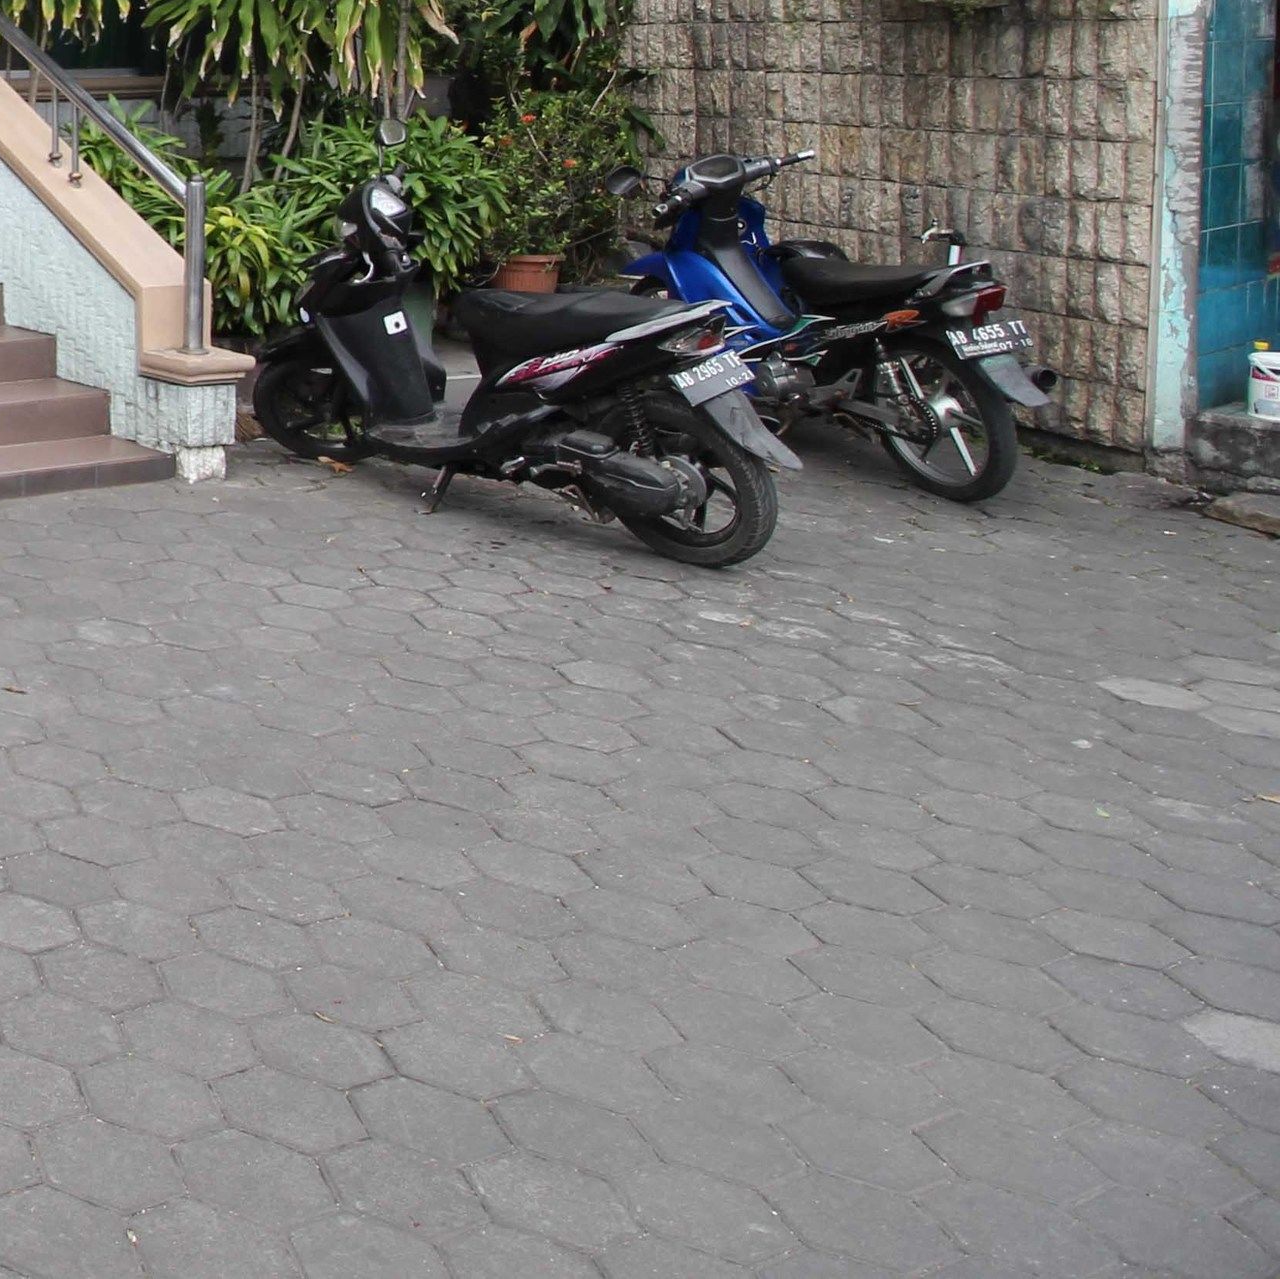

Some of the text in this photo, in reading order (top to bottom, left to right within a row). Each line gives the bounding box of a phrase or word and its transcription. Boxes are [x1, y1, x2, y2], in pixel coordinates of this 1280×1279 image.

[949, 320, 1027, 345] AB 4655 TT
[675, 351, 741, 388] AB 2965 TF
